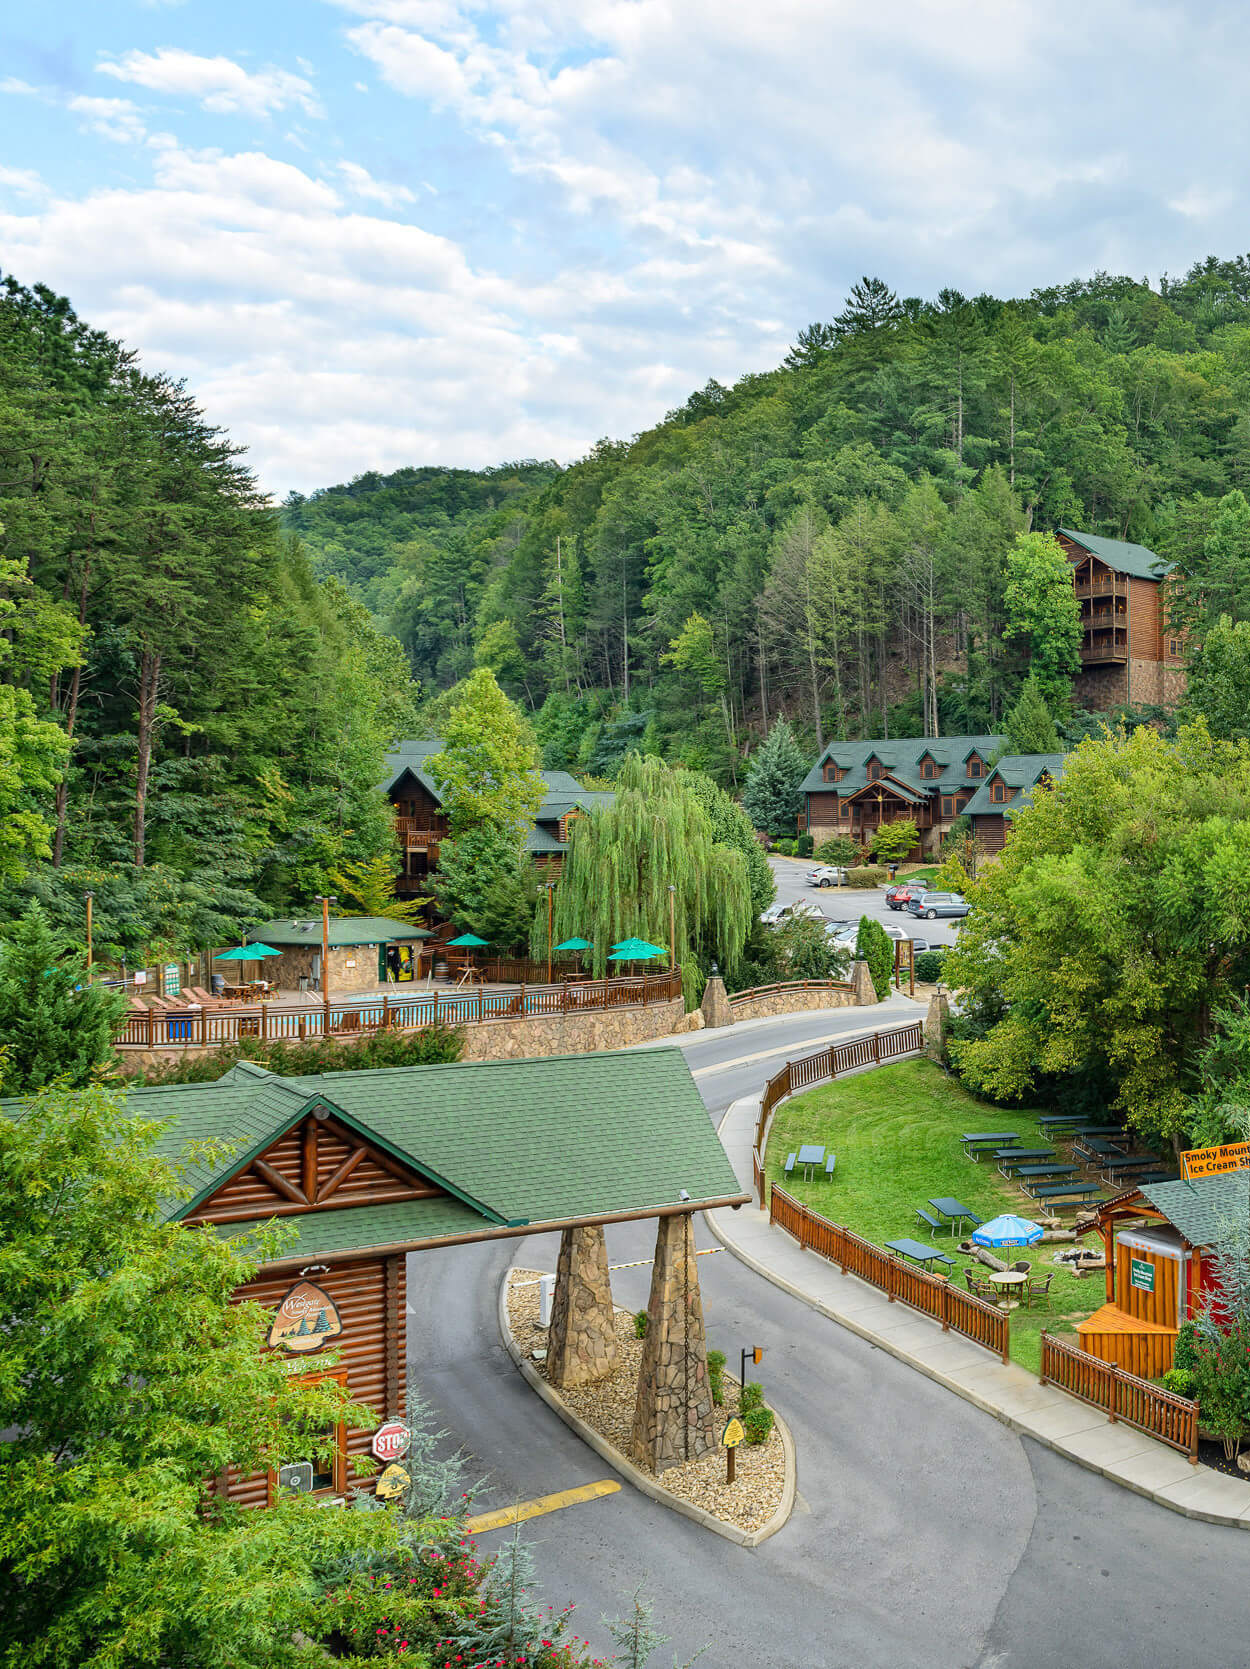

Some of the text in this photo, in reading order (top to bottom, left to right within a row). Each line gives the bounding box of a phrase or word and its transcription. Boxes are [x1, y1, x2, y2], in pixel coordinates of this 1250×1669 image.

[1185, 1150, 1217, 1162] Smoky
[1190, 1164, 1204, 1174] Ice
[1206, 1161, 1237, 1172] Cream
